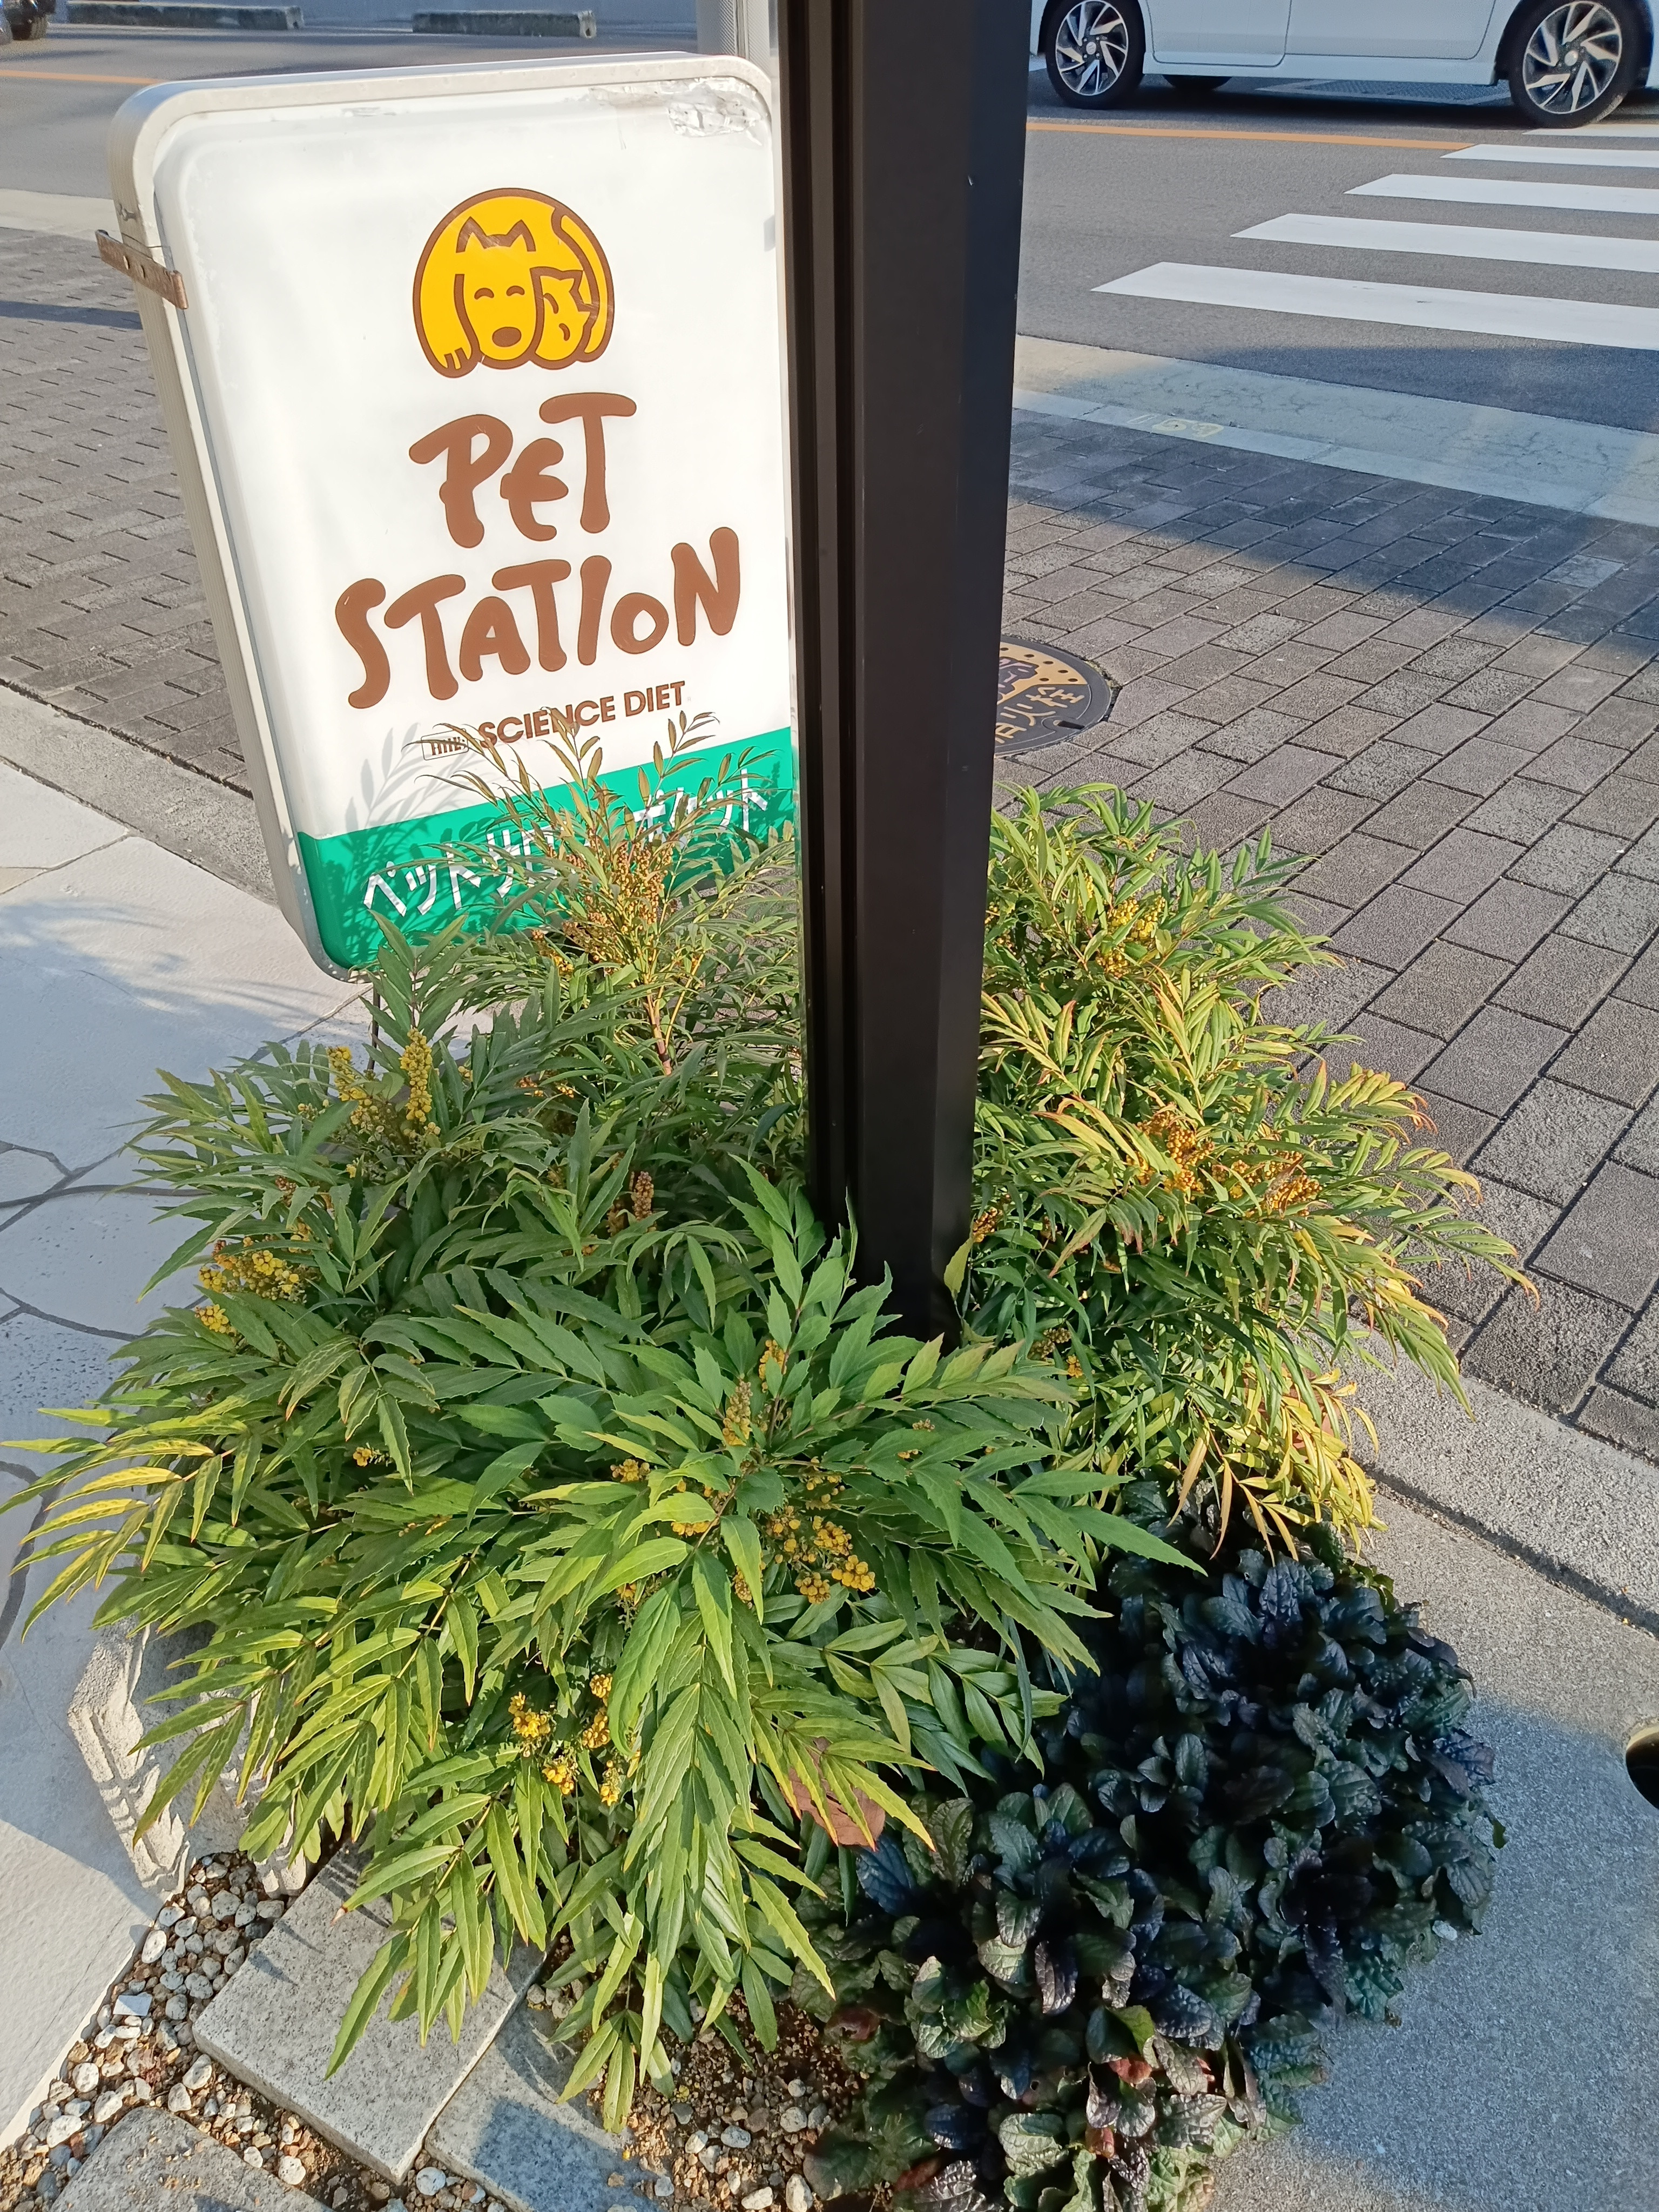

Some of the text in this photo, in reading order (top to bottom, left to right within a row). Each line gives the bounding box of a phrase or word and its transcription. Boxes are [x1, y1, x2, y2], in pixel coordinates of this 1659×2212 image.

[409, 392, 637, 549] PET
[335, 527, 740, 709] STATION
[624, 680, 685, 717] DIET
